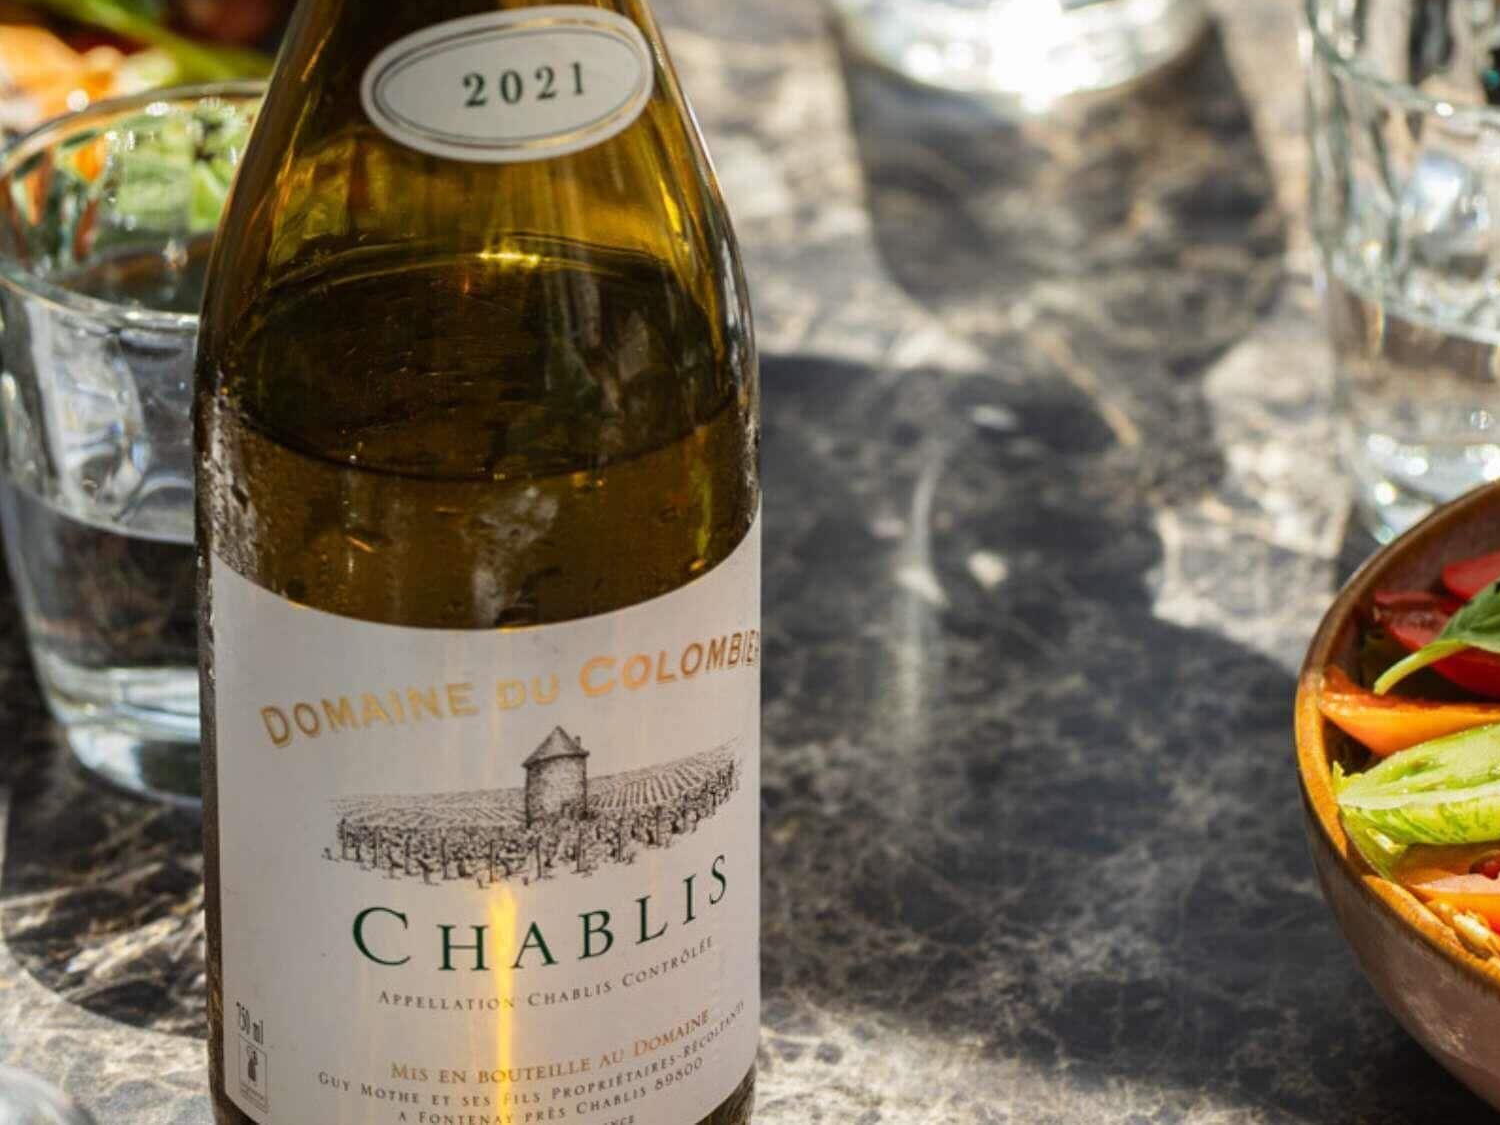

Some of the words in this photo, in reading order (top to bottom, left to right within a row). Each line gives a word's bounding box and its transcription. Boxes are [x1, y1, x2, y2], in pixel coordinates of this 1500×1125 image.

[462, 62, 584, 107] 2021
[259, 682, 480, 748] DOMAINE
[495, 674, 559, 710] DU
[352, 854, 727, 971] CHABLIS
[378, 991, 515, 1011] APPELLATION
[528, 981, 613, 1007] CHABLIS
[252, 1019, 264, 1046] ml
[391, 1062, 430, 1082] MIS
[439, 1070, 467, 1084] EN
[478, 1058, 592, 1084] BOUTEILLE
[599, 1049, 625, 1068] AU
[632, 1009, 710, 1057] DOMAINE
[318, 1071, 351, 1092] GUY
[361, 1083, 419, 1105] MOTHE
[432, 1095, 450, 1106] ET
[463, 1095, 491, 1107] SES
[576, 1085, 648, 1116] CHABLIS
